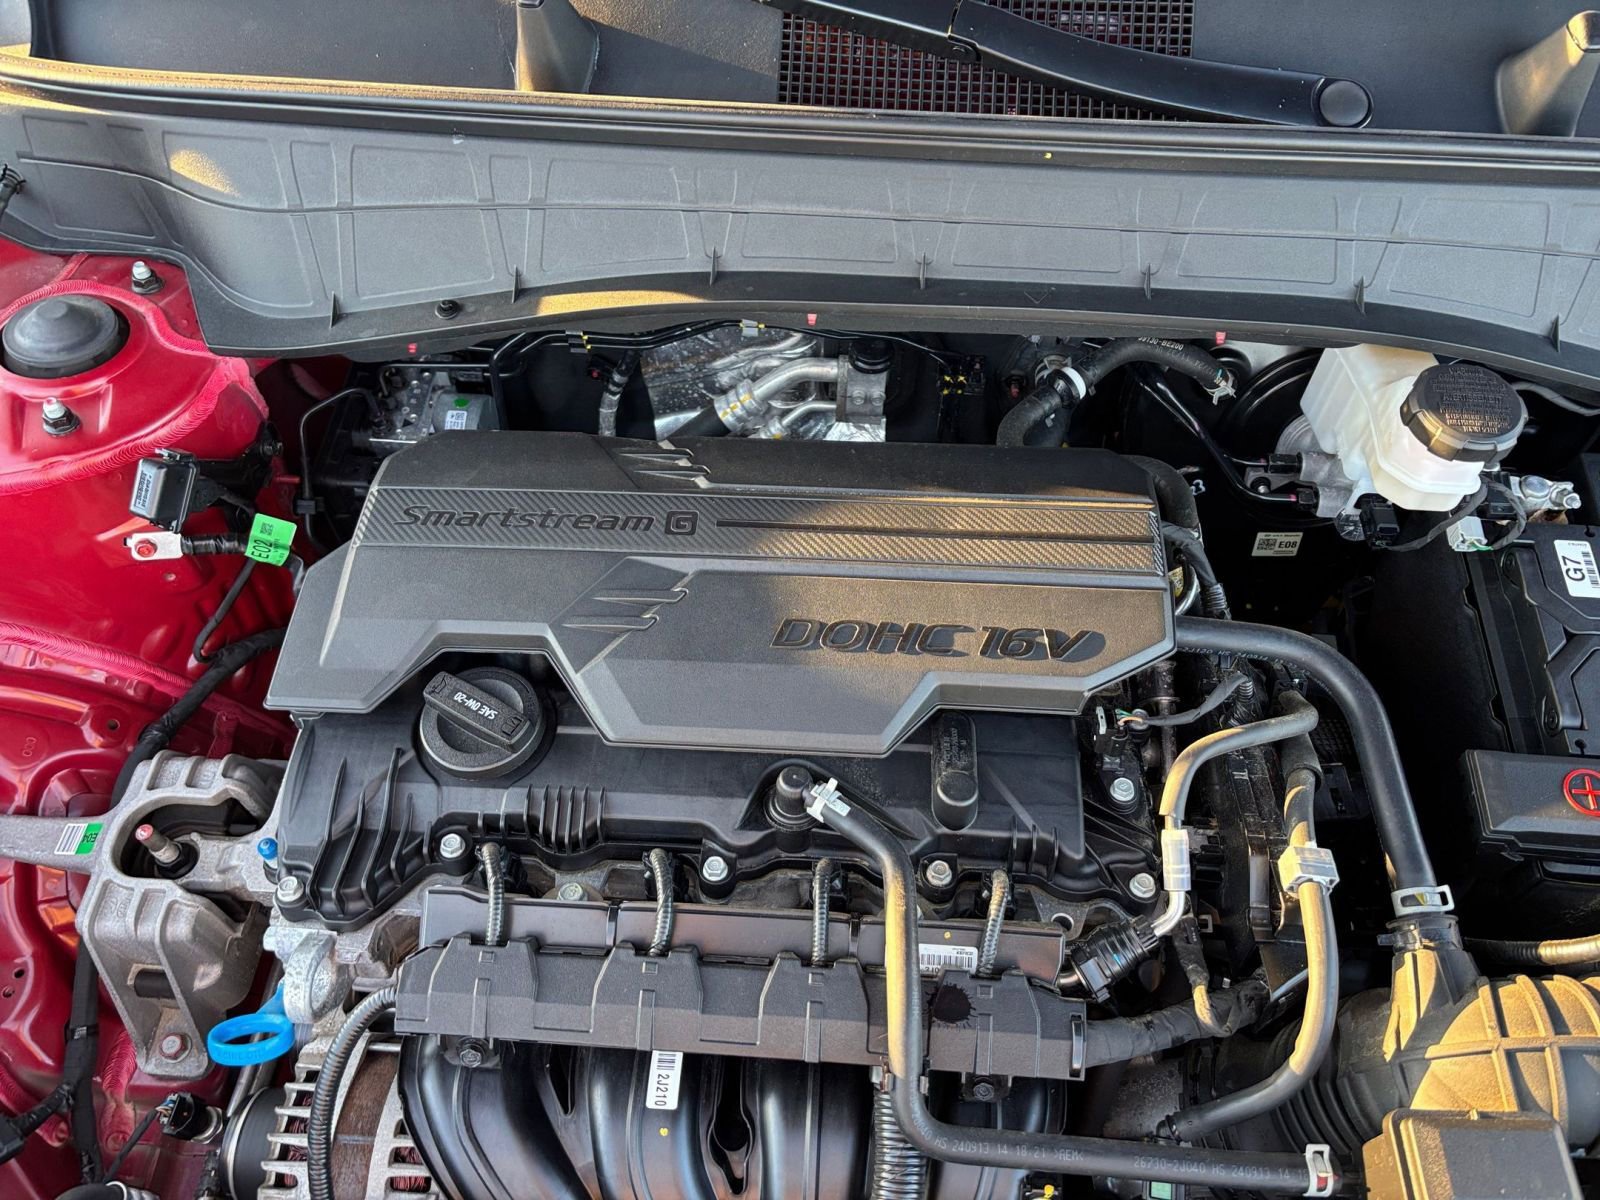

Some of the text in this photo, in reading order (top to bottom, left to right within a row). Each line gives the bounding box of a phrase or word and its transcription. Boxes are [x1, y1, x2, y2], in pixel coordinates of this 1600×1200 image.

[393, 504, 656, 532] Smartstream
[251, 539, 273, 559] E02
[1278, 540, 1298, 549] E08
[1561, 555, 1586, 582] G7
[770, 617, 1096, 661] DOHC 16V
[453, 691, 499, 720] SAE 0W-20
[654, 1073, 671, 1107] 2J210
[1212, 1162, 1226, 1176] HS
